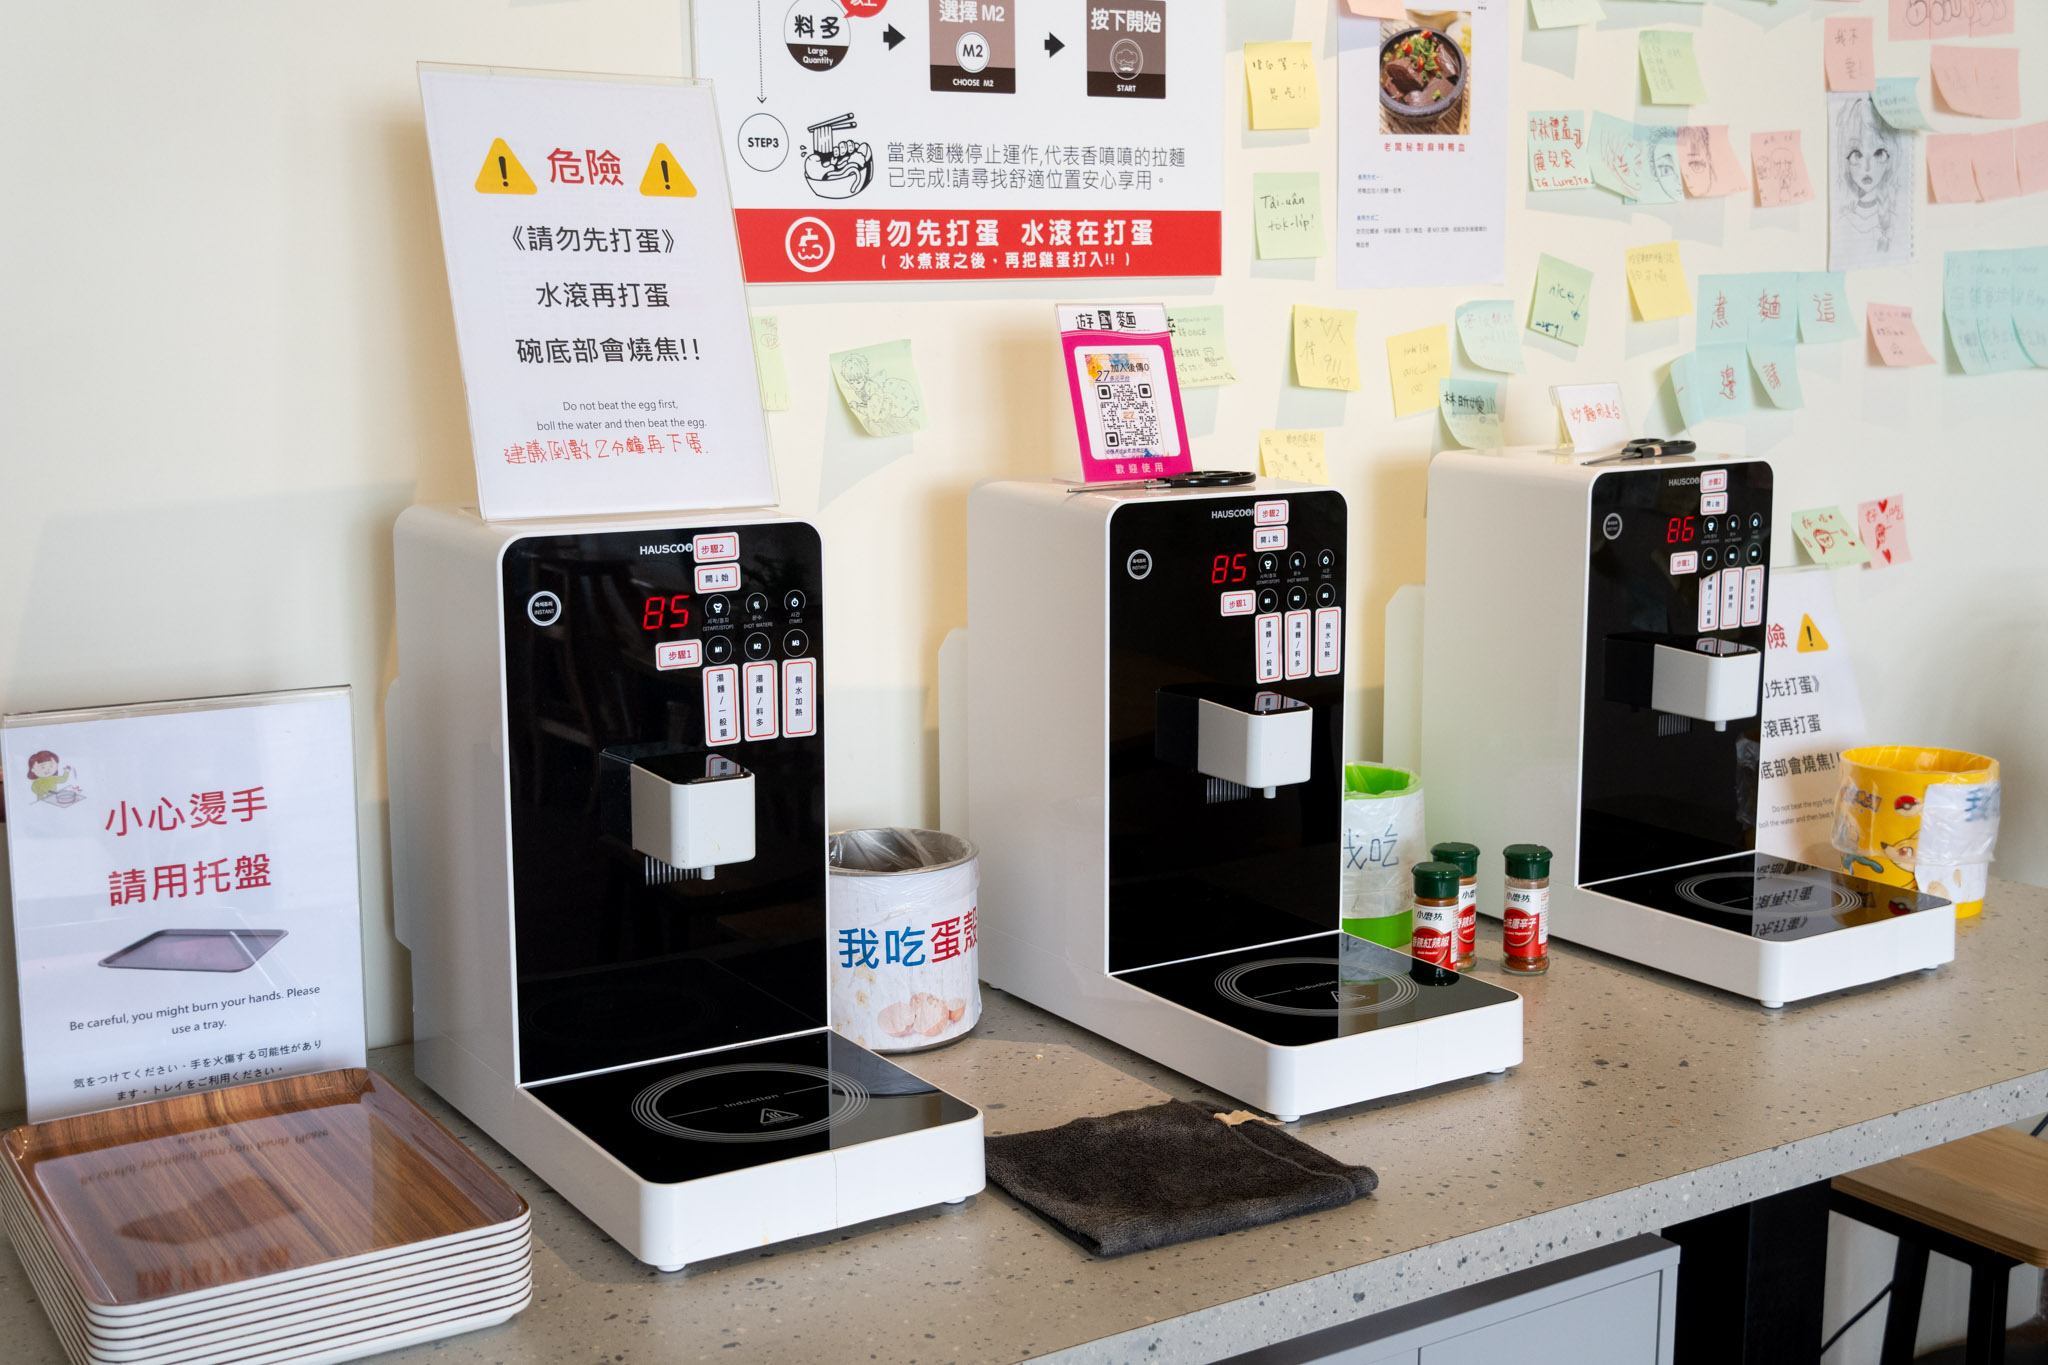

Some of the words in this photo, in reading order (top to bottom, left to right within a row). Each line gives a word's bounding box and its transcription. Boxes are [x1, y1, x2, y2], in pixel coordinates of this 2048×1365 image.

[981, 4, 1005, 23] M2
[1091, 8, 1161, 33] 按下開始
[794, 15, 841, 39] 料多
[807, 47, 828, 57] Large
[962, 44, 983, 58] M2
[802, 56, 834, 66] Quantity
[952, 77, 980, 87] CHOOSE
[983, 78, 994, 87] M2
[1116, 84, 1136, 92] START
[747, 137, 779, 149] STEP3
[547, 147, 624, 186] 危險
[511, 225, 676, 254] 《請勿先打蛋》
[856, 219, 999, 248] 請勿先打蛋
[1020, 219, 1153, 246] 水滾在打蛋
[536, 282, 671, 308] 水滾再打蛋
[516, 337, 700, 364] 碗底部會燒焦!!
[1095, 370, 1110, 382] 27
[563, 401, 576, 411] Do
[580, 401, 595, 411] not
[598, 400, 619, 410] beat
[621, 400, 636, 410] the
[638, 402, 656, 412] egg
[658, 399, 678, 410] first,
[558, 419, 574, 430] the
[576, 420, 602, 430] water
[604, 418, 622, 429] and
[624, 418, 646, 428] then
[648, 417, 668, 428] beat
[670, 417, 685, 427] the
[687, 418, 708, 429] egg.
[1667, 516, 1695, 543] 86
[701, 544, 725, 554] 步驟2
[1211, 553, 1247, 584] 85
[643, 595, 690, 630] 85
[668, 650, 692, 661] 步驟1
[715, 646, 724, 654] M1
[1763, 714, 1822, 738] 滾再打蛋
[105, 786, 269, 837] 小心燙手
[109, 853, 272, 906] 請用托盤
[1416, 910, 1443, 922] 小磨坊
[70, 1021, 84, 1031] Be
[87, 1014, 129, 1028] careful,
[132, 1012, 153, 1024] you
[156, 1005, 190, 1018] might
[192, 1001, 218, 1012] burn
[221, 997, 246, 1010] your
[248, 990, 284, 1003] hands.
[287, 985, 320, 998] Please
[171, 1024, 191, 1035] use
[194, 1023, 200, 1031] a
[203, 1018, 227, 1031] tray.
[724, 1094, 779, 1108] Induction
